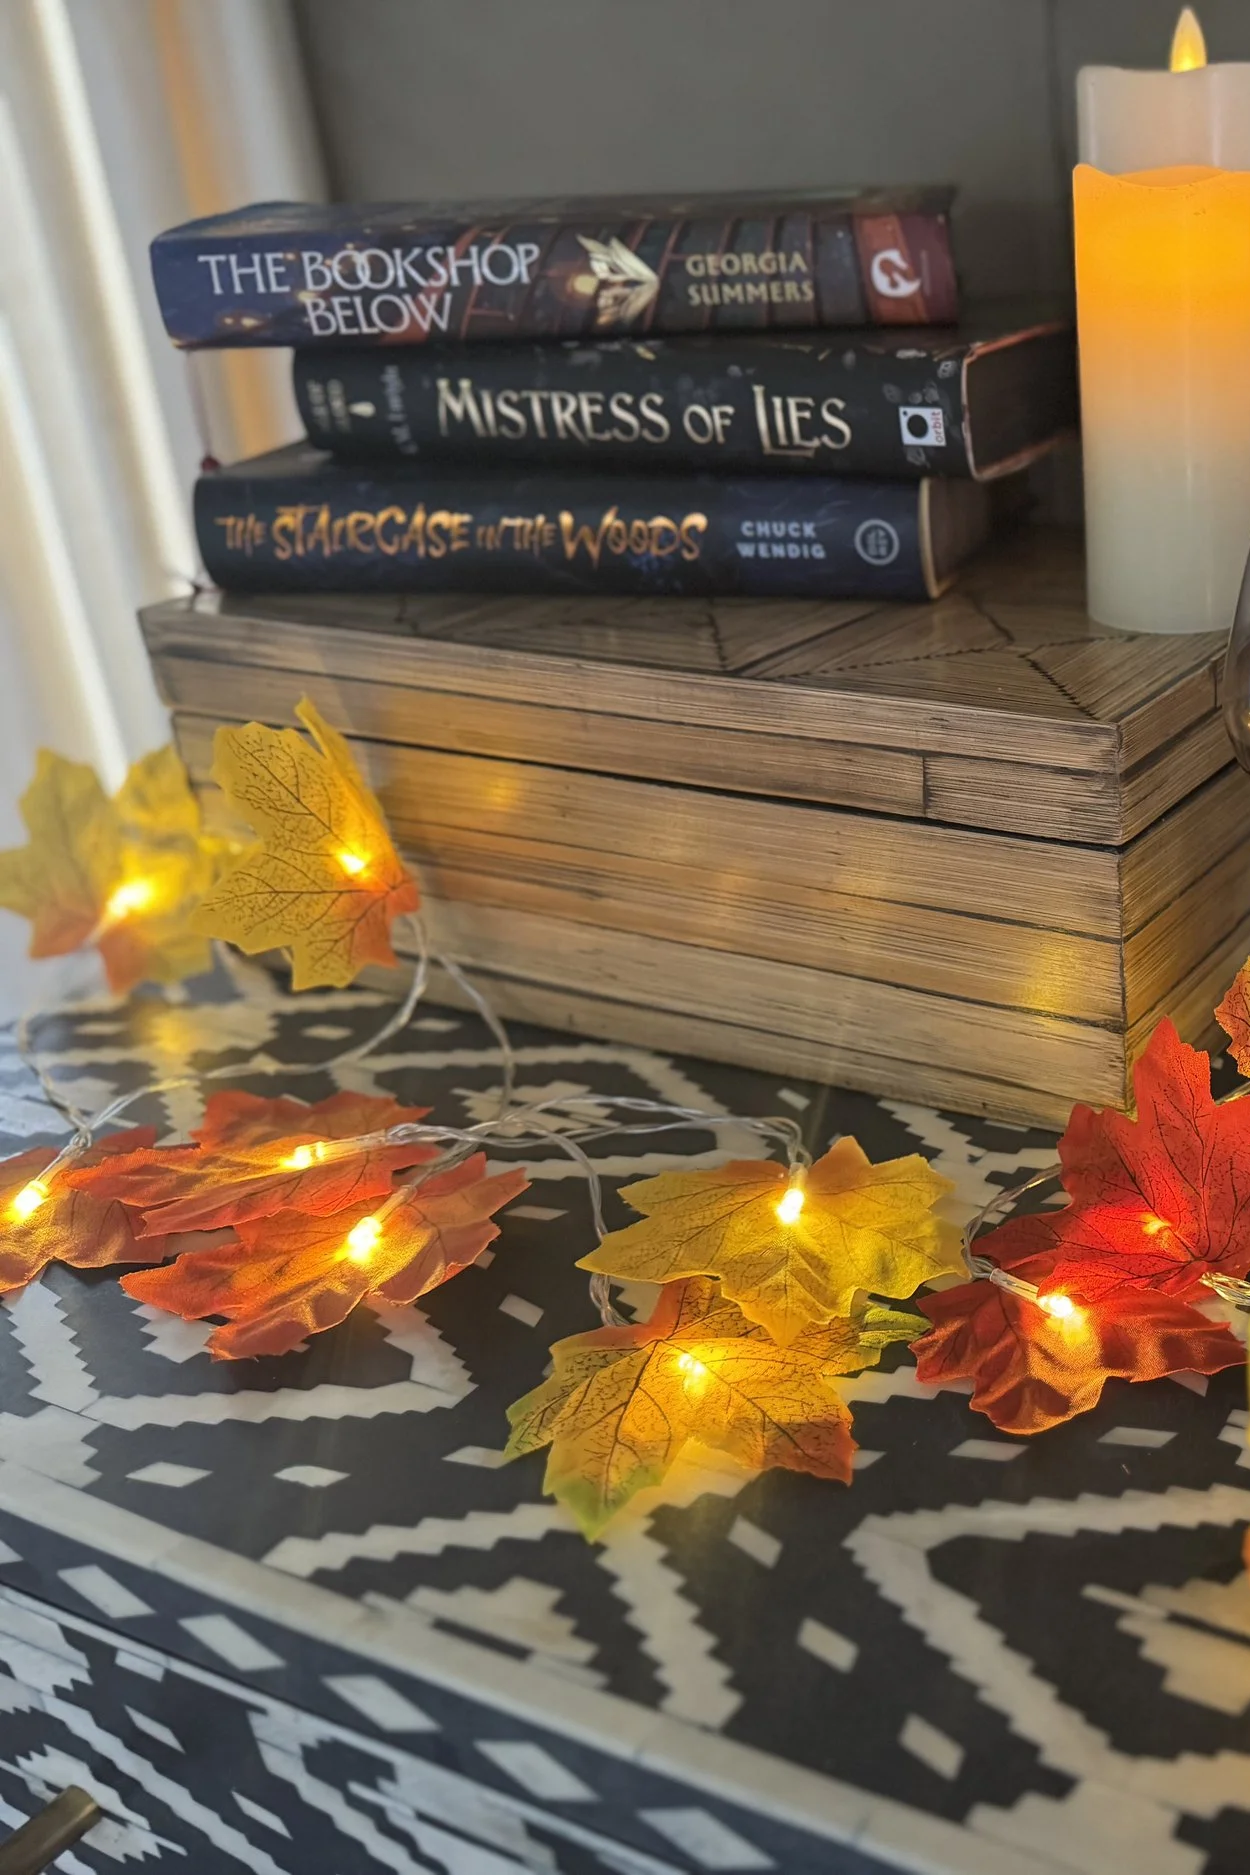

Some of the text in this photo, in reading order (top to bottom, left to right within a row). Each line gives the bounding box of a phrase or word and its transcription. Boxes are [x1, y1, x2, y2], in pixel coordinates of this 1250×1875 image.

[198, 243, 541, 295] THE BOOKSHOP
[685, 251, 808, 278] GEORGIA
[688, 280, 814, 306] SUMMERS
[305, 293, 452, 336] BELOW
[436, 377, 672, 444] MISTRESS
[683, 404, 735, 444] OF
[753, 385, 852, 458] LIES
[930, 410, 945, 444] orbit
[215, 513, 267, 554] THE
[558, 506, 707, 566] WOODS
[740, 521, 817, 540] CHUCK
[736, 542, 826, 560] WENDIG
